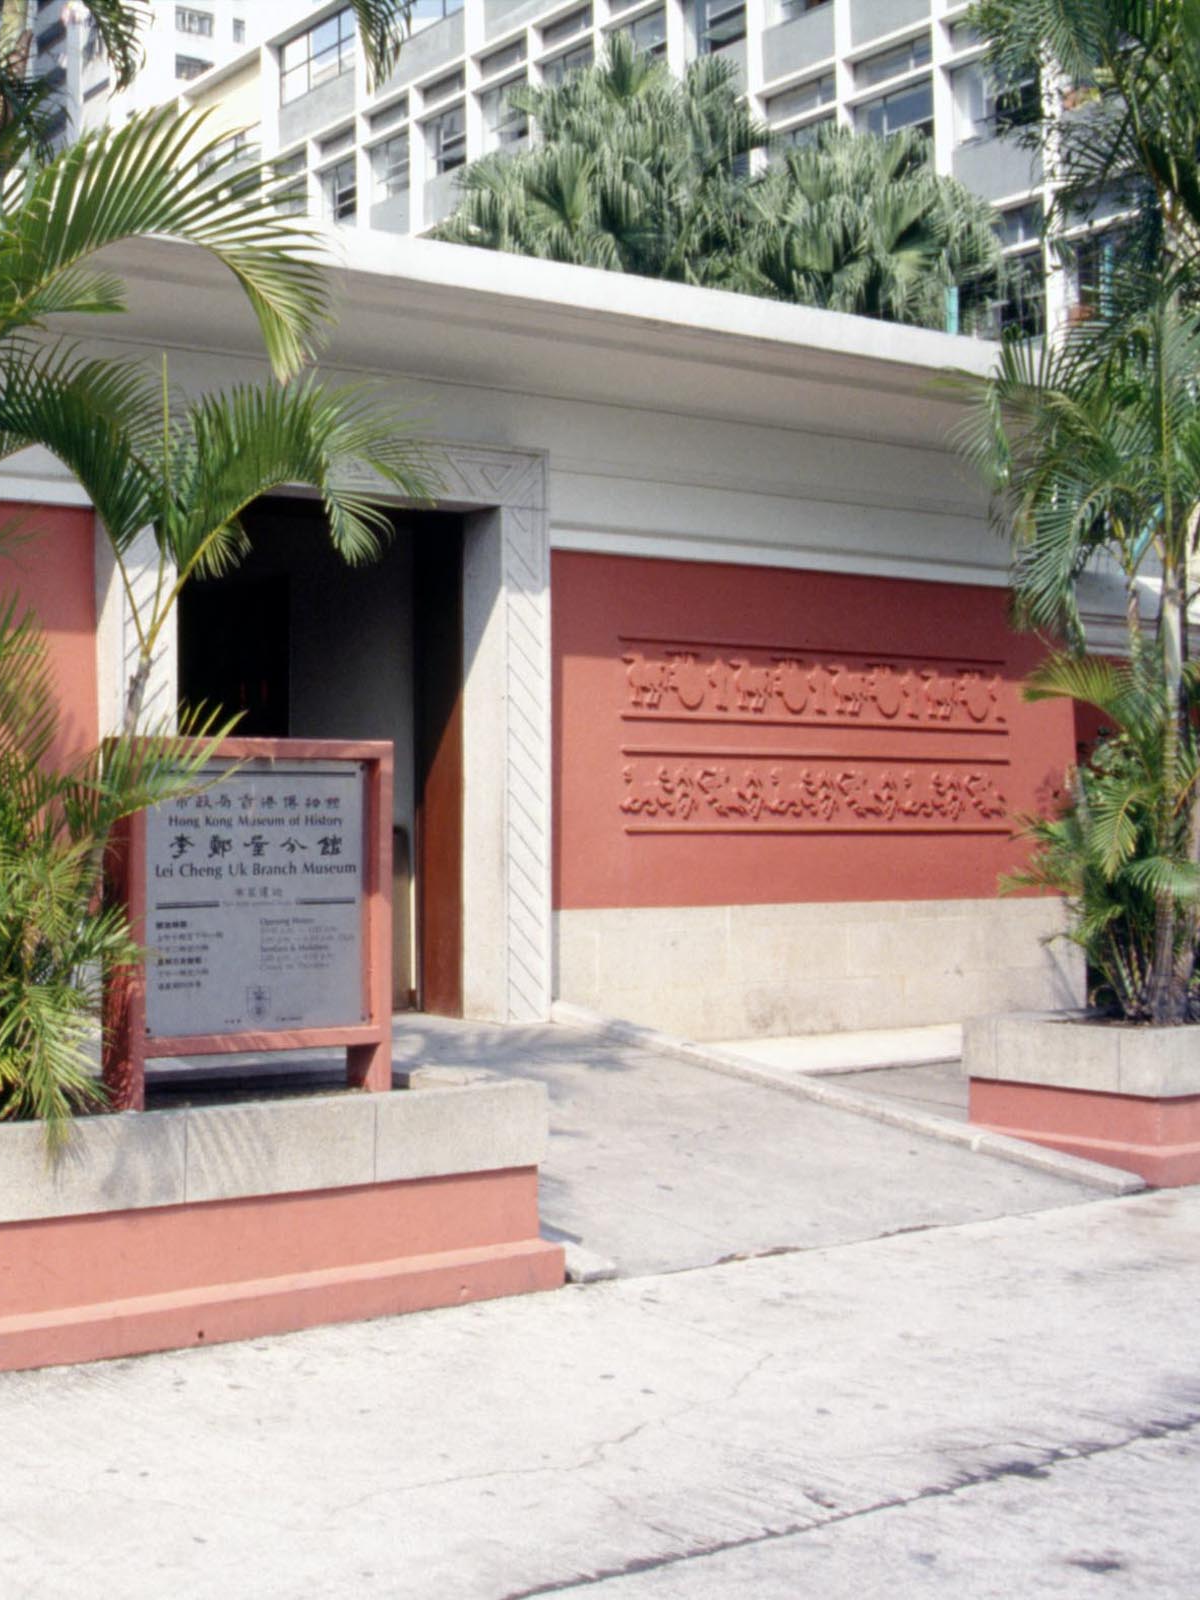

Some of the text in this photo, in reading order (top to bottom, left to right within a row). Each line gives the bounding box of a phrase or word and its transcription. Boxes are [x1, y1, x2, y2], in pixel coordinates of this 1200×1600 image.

[168, 815, 200, 829] Hong
[205, 815, 233, 828] Kong
[288, 814, 300, 826] of
[304, 814, 343, 828] History
[155, 861, 358, 879] Lei Cheng Uk Branch Museum
